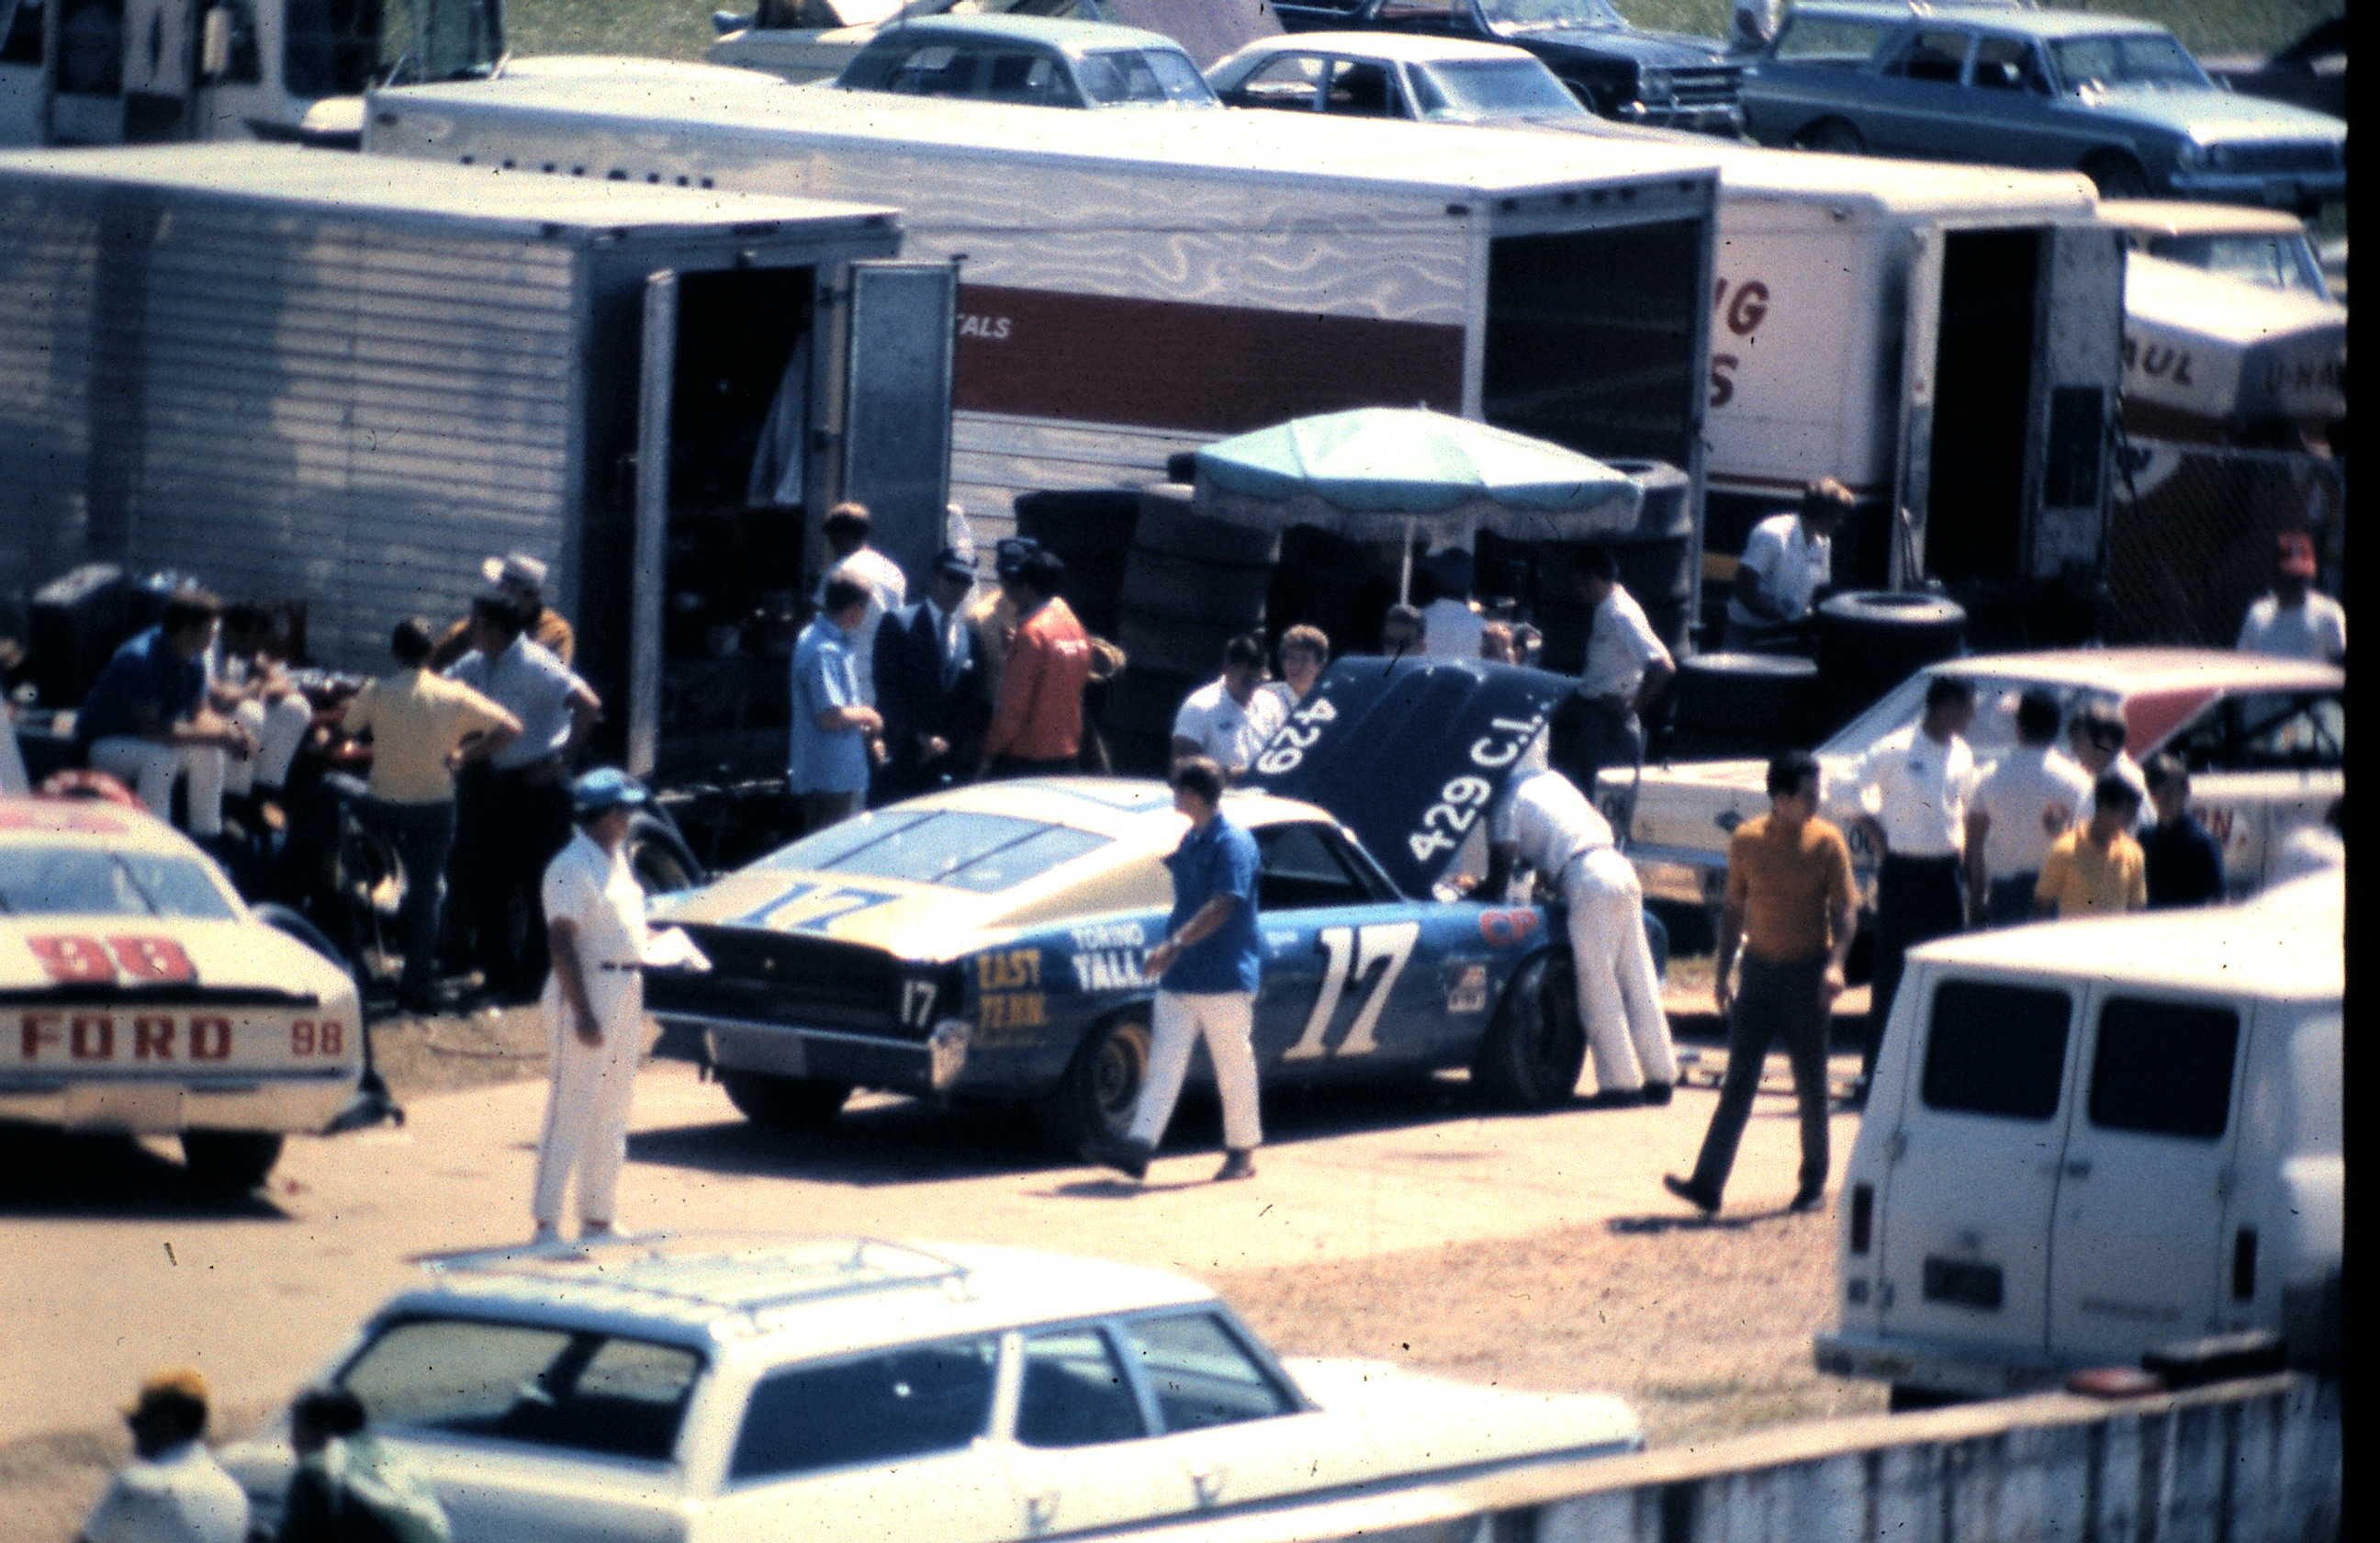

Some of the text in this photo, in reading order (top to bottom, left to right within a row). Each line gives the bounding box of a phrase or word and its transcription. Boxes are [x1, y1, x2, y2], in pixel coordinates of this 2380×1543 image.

[1257, 698, 1337, 772] 429
[1409, 776, 1491, 863] 429
[1471, 715, 1544, 767] C.I.
[740, 882, 902, 930] 17
[978, 949, 1041, 990] EAST
[1072, 950, 1161, 991] TALL
[1283, 922, 1420, 1060] 17
[902, 979, 937, 1028] 17
[20, 1012, 342, 1062] FORD 98
